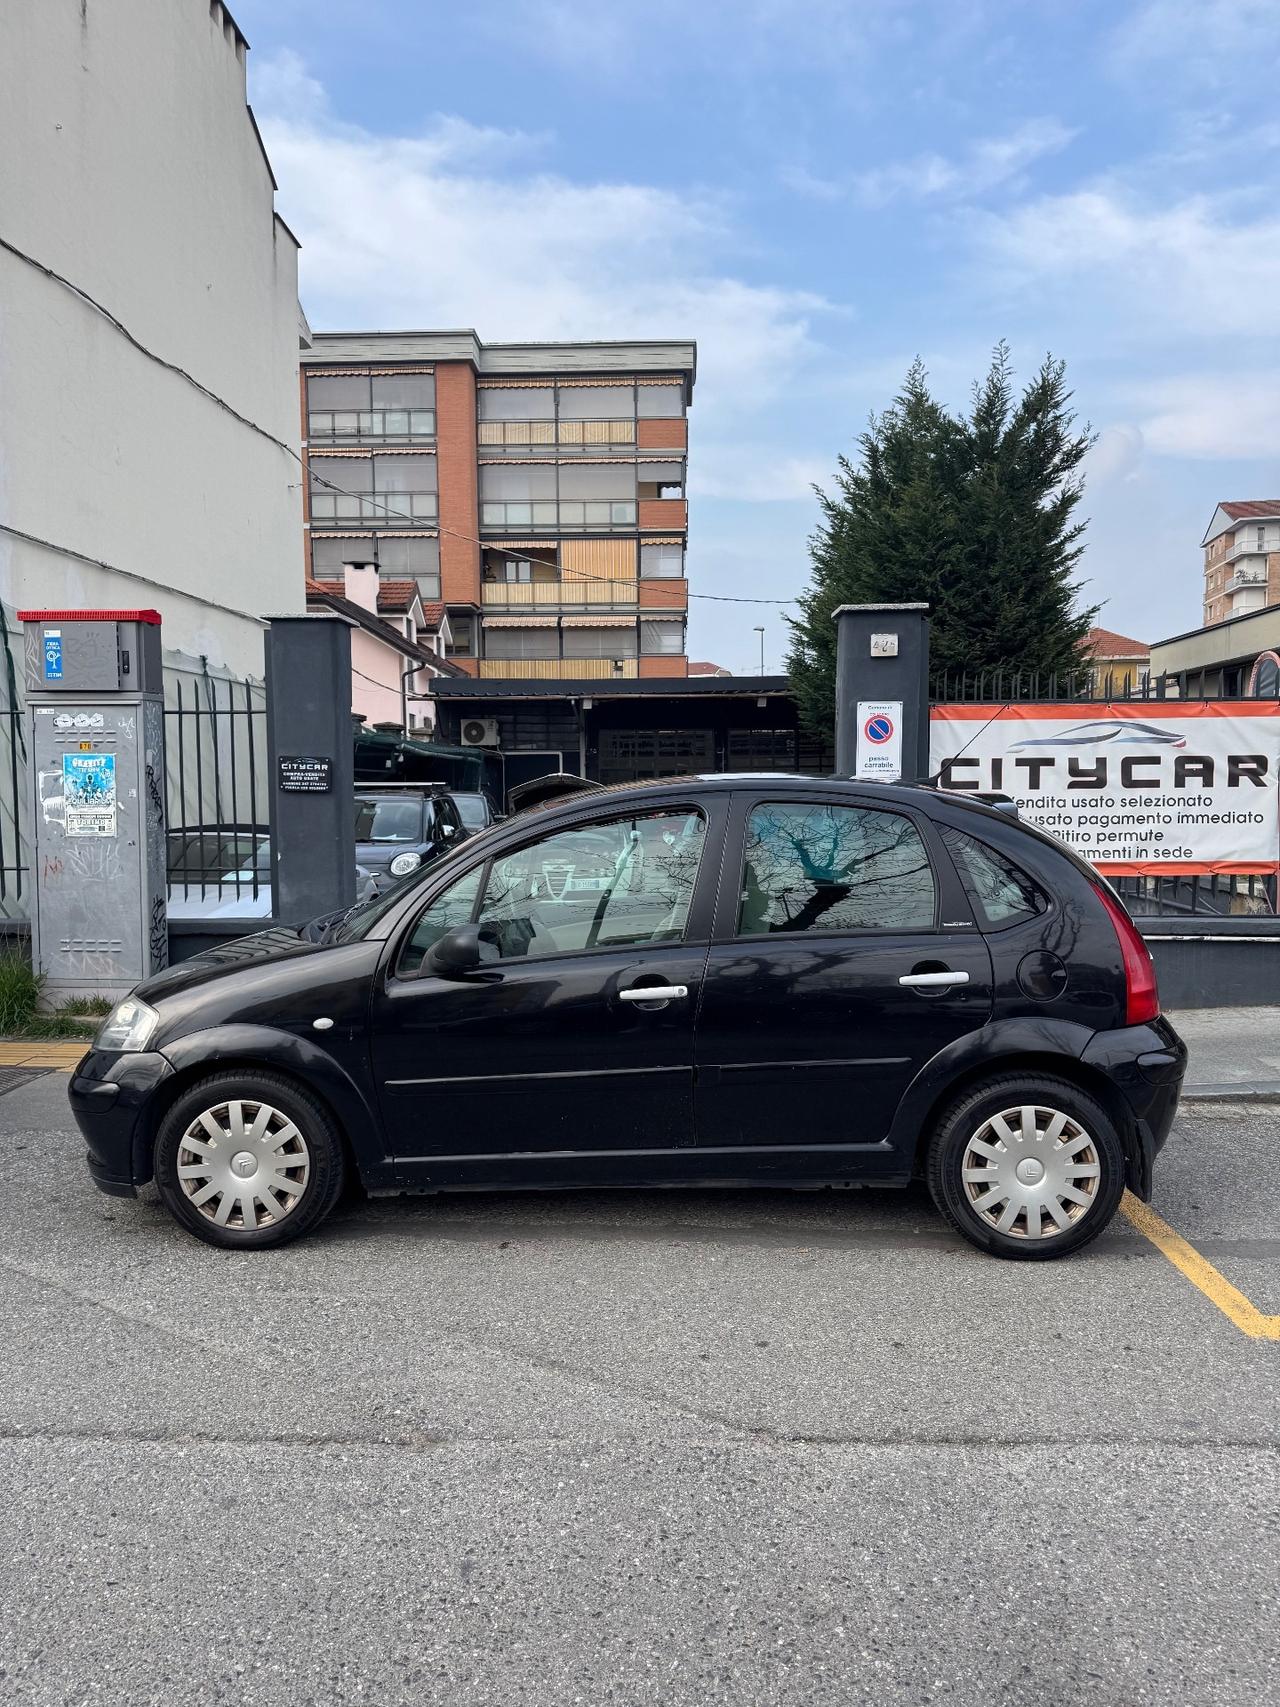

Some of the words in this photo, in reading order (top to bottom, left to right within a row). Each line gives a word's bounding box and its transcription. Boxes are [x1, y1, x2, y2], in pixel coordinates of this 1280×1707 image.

[940, 754, 1270, 790] CITYCAR
[1012, 796, 1067, 809] endita
[1071, 796, 1115, 808] usato
[1120, 794, 1213, 808] selezionato
[1077, 813, 1173, 828] pagamento
[1177, 811, 1264, 824] immediato
[1096, 830, 1164, 844] permute
[1135, 846, 1148, 859] in
[1152, 846, 1193, 859] sede
